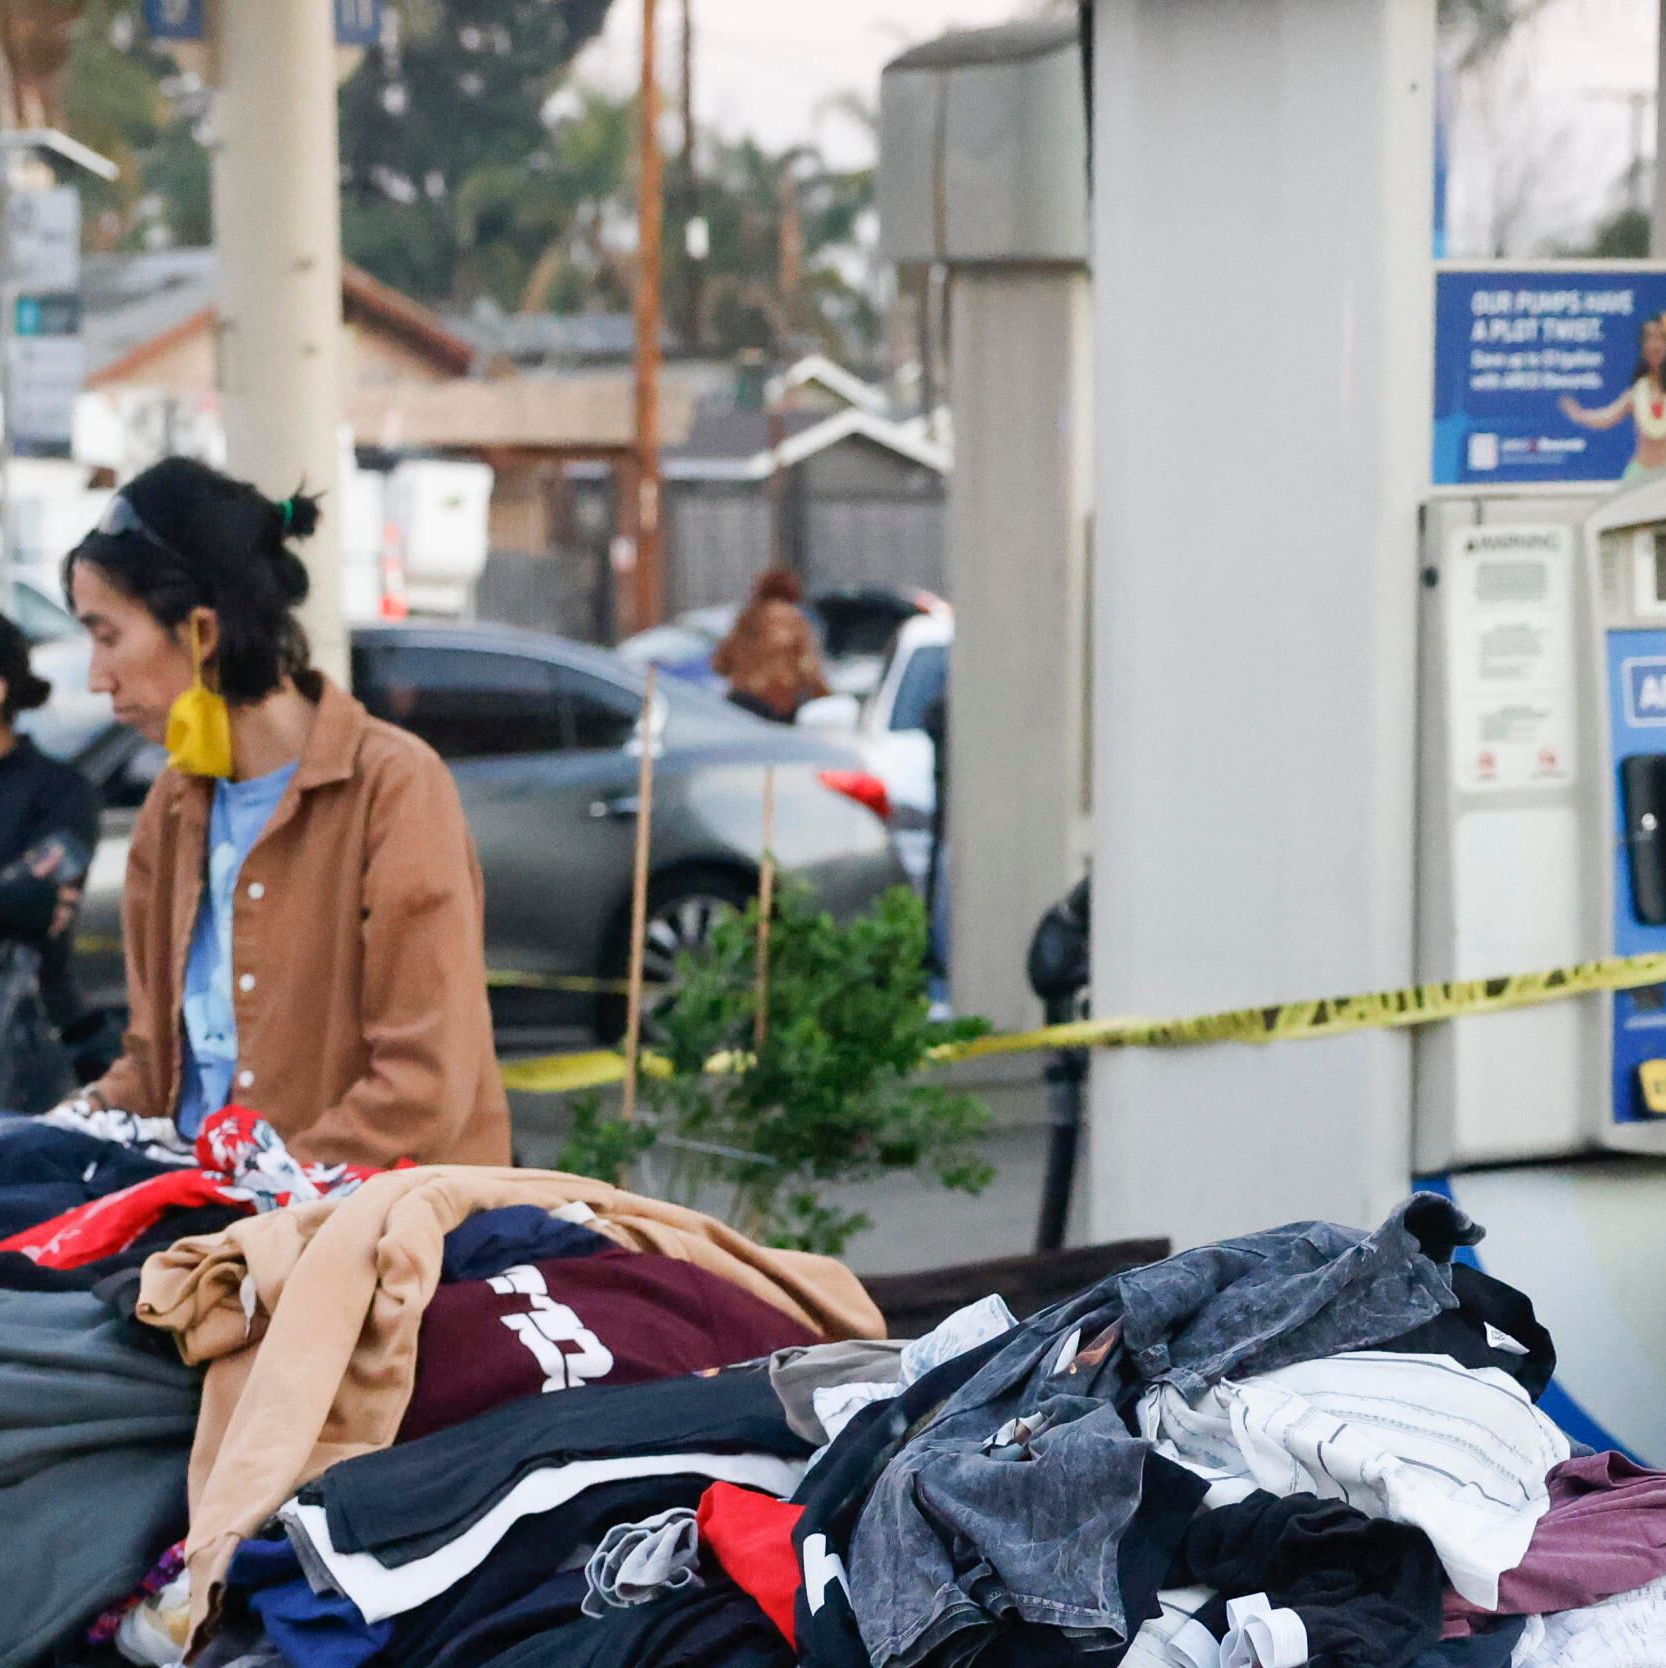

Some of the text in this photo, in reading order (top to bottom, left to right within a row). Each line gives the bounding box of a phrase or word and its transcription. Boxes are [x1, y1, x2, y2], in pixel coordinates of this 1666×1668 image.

[1471, 289, 1634, 316] OUR PUMPS HAVE
[1470, 318, 1487, 342] A
[1489, 317, 1539, 343] PLOT
